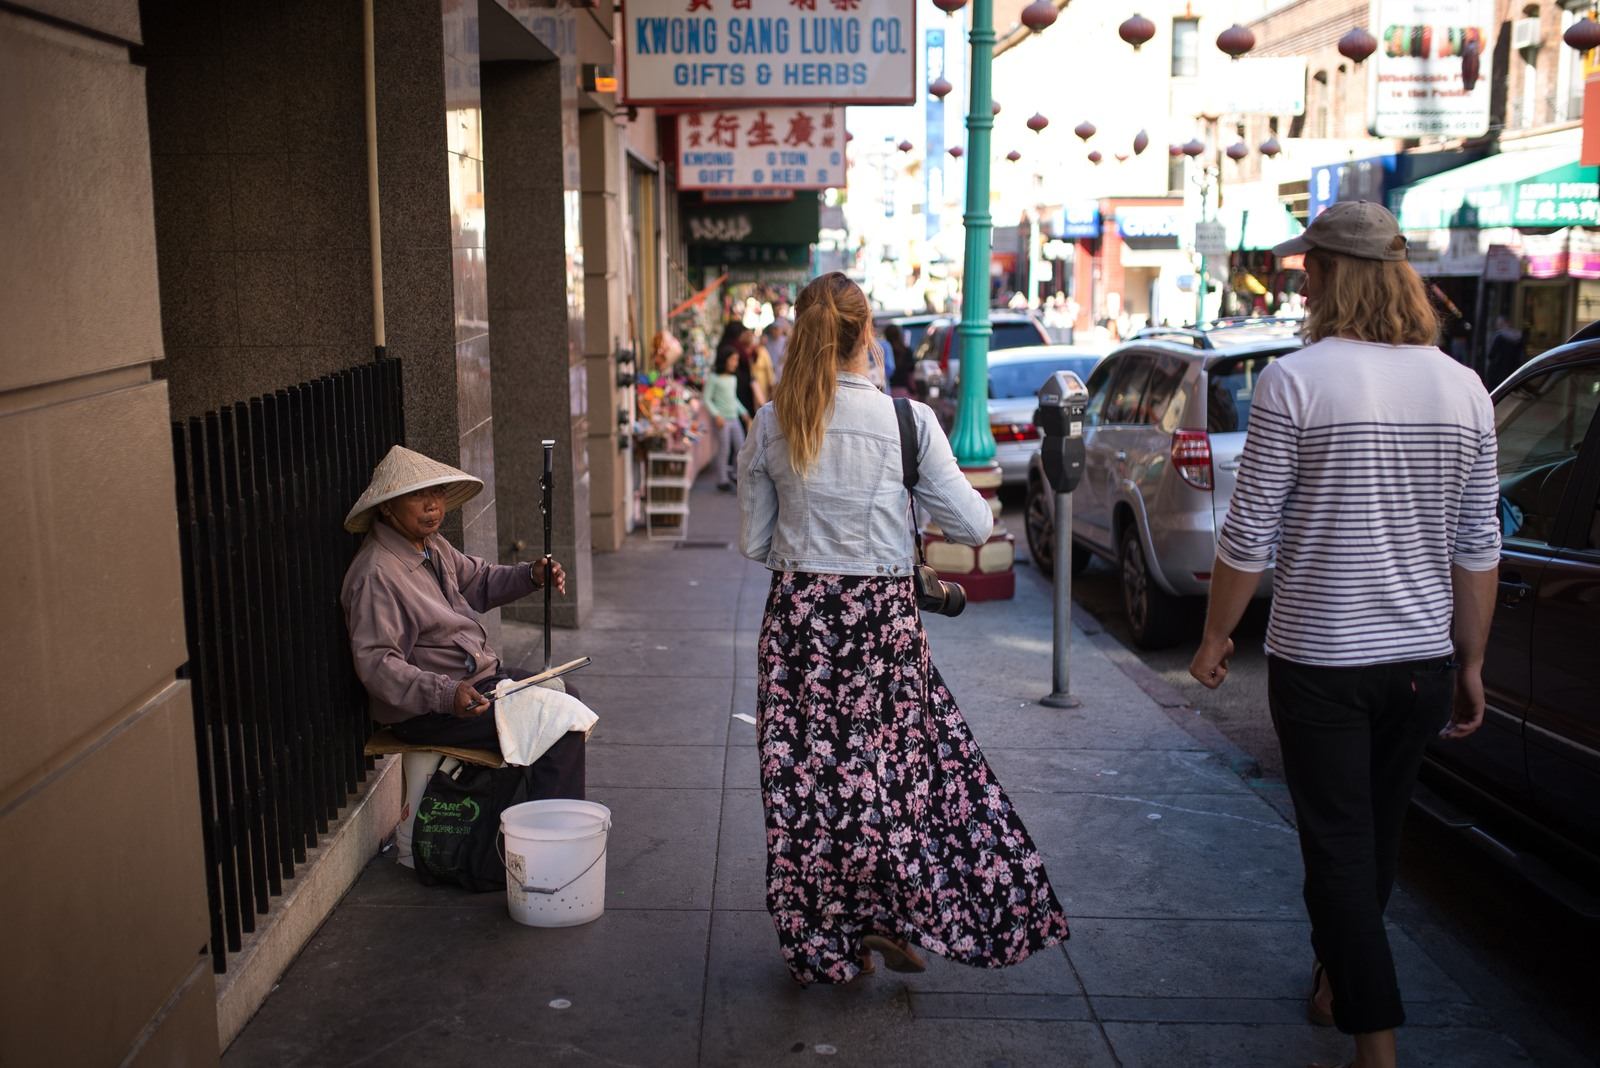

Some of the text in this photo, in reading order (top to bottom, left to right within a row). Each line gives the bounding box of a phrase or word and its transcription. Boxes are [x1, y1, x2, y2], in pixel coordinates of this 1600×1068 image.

[636, 17, 907, 54] KWONG SANG LUNG CO.
[674, 63, 868, 86] GIFTS & HERBS
[683, 152, 734, 166] KWONG
